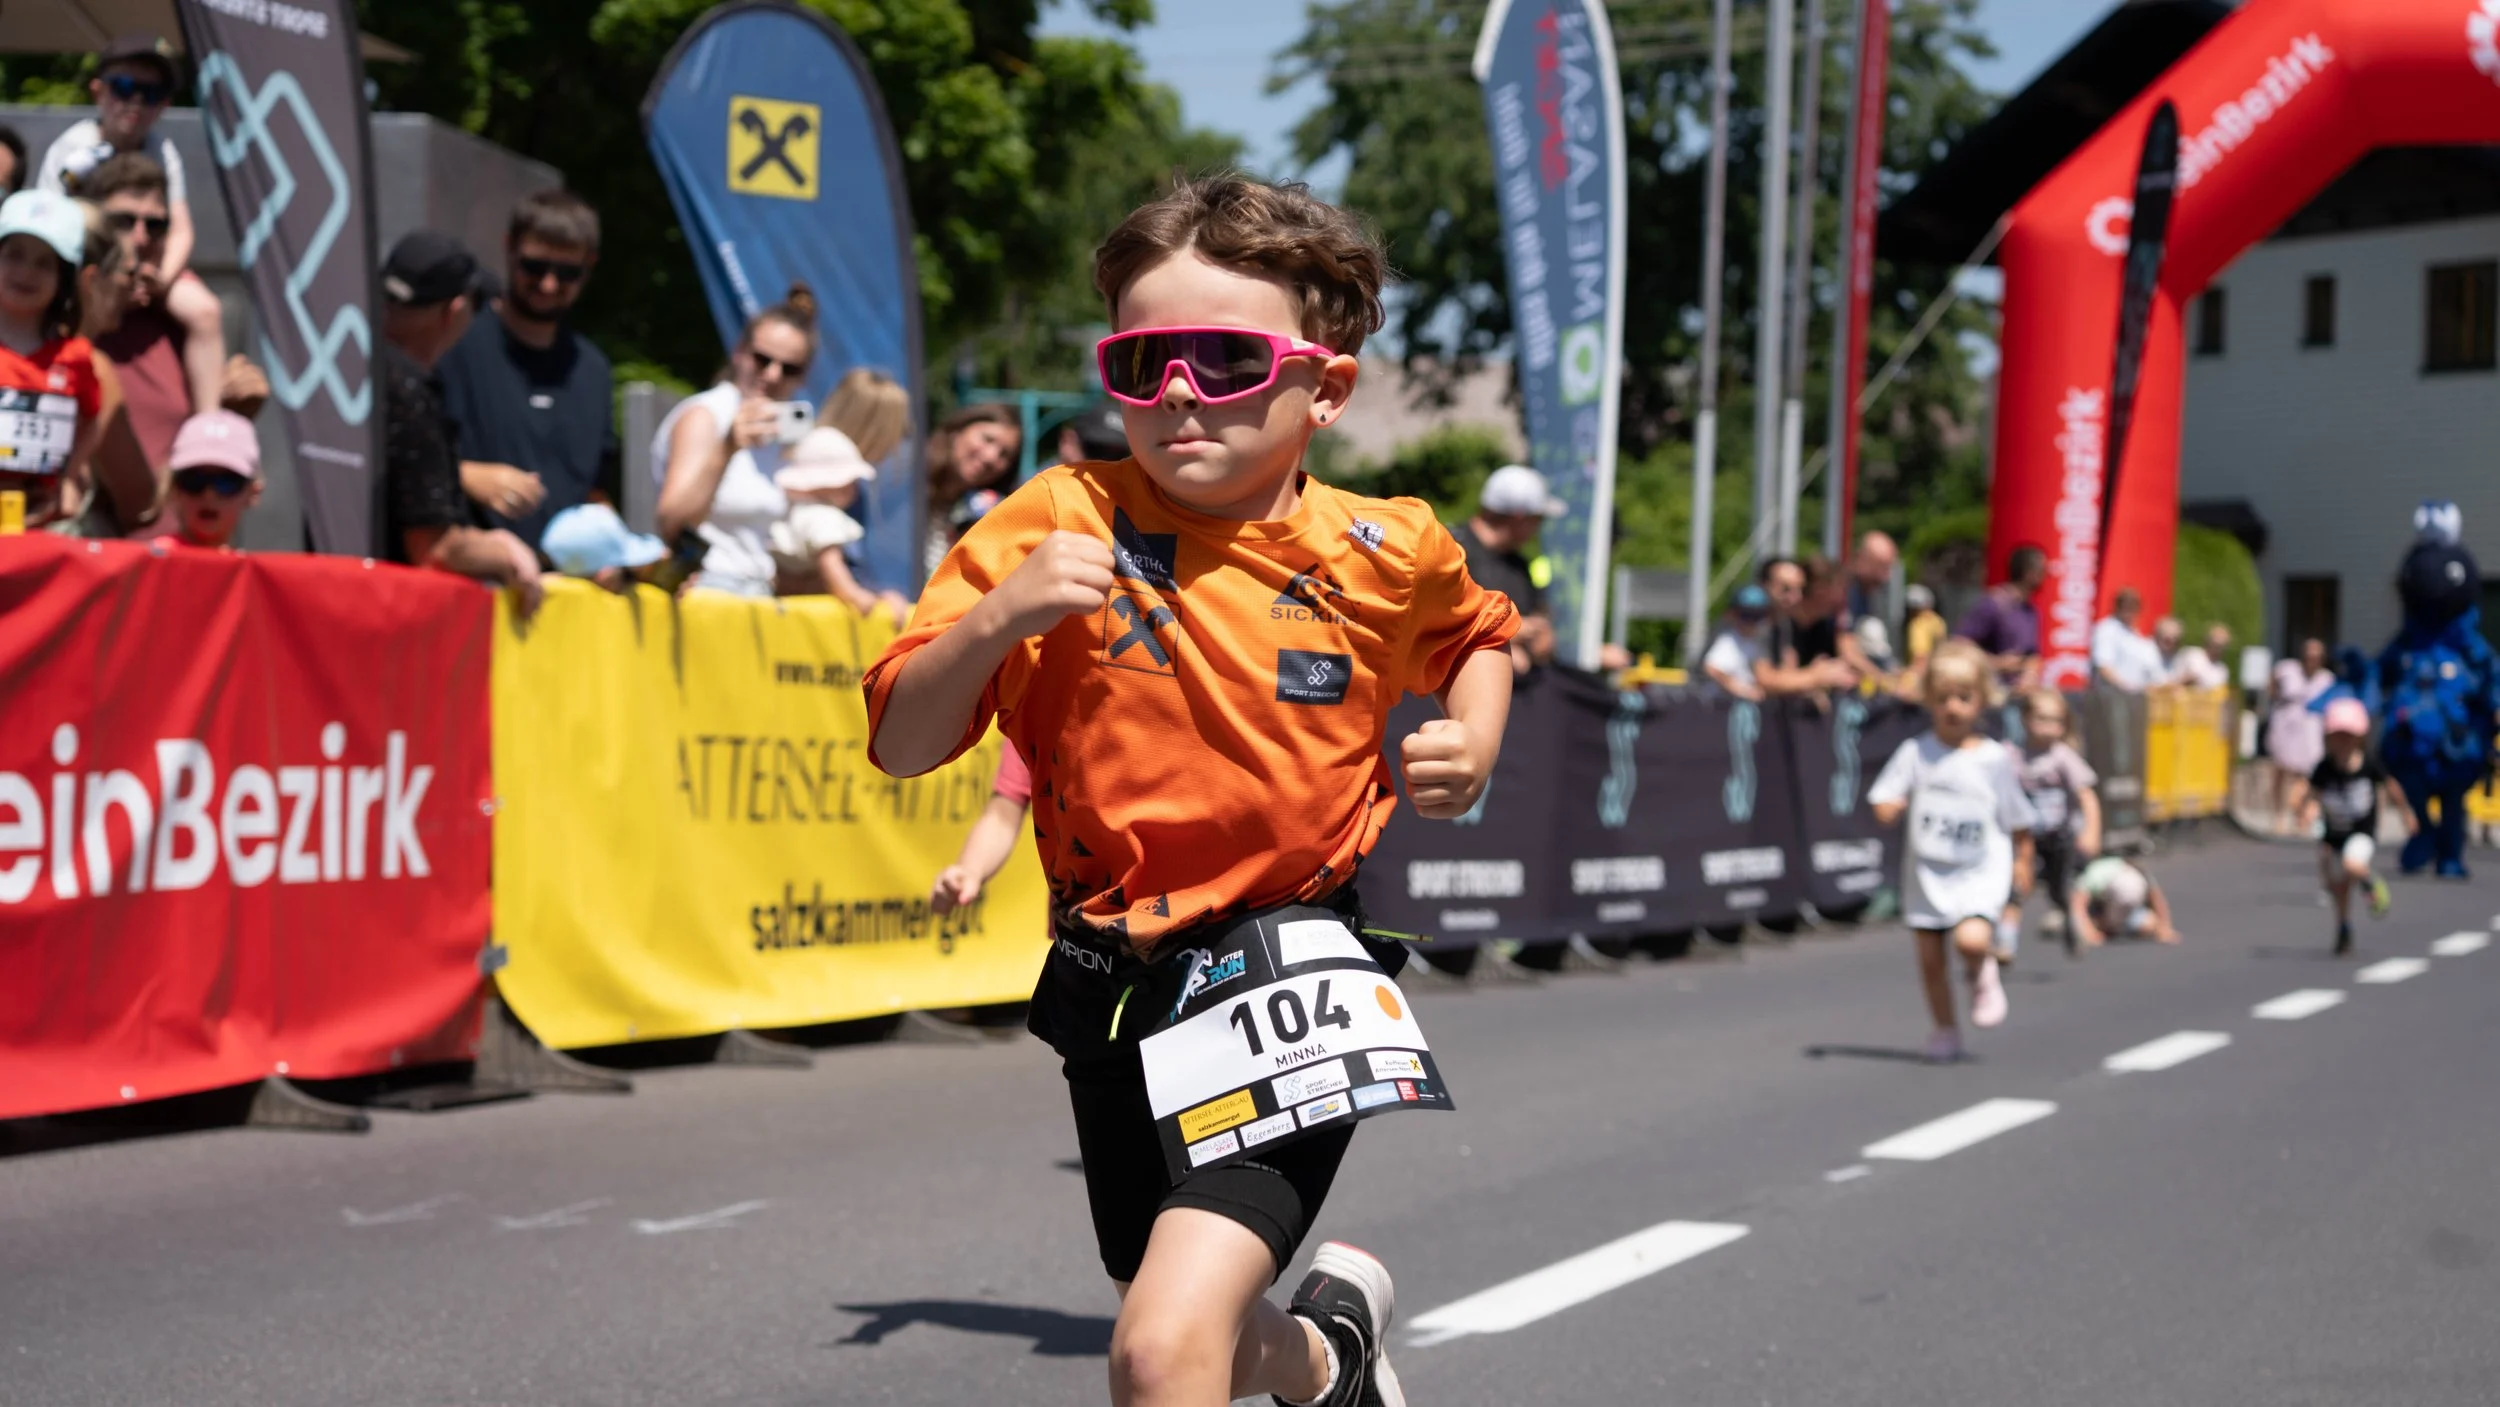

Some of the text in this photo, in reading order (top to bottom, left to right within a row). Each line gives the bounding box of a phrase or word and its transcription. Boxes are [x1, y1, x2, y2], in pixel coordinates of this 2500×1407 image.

[2173, 32, 2336, 198] einBezirk
[1270, 607, 1358, 627] SICKIN
[1220, 950, 1244, 965] ATTER
[1207, 956, 1246, 985] RUN
[1230, 979, 1352, 1056] 104
[1275, 1043, 1327, 1068] MINNA
[1305, 1079, 1327, 1089] SPORT
[1307, 1080, 1344, 1095] STREICHER
[1198, 1113, 1241, 1132] salzkammergut
[1246, 1122, 1291, 1143] Eggenberg
